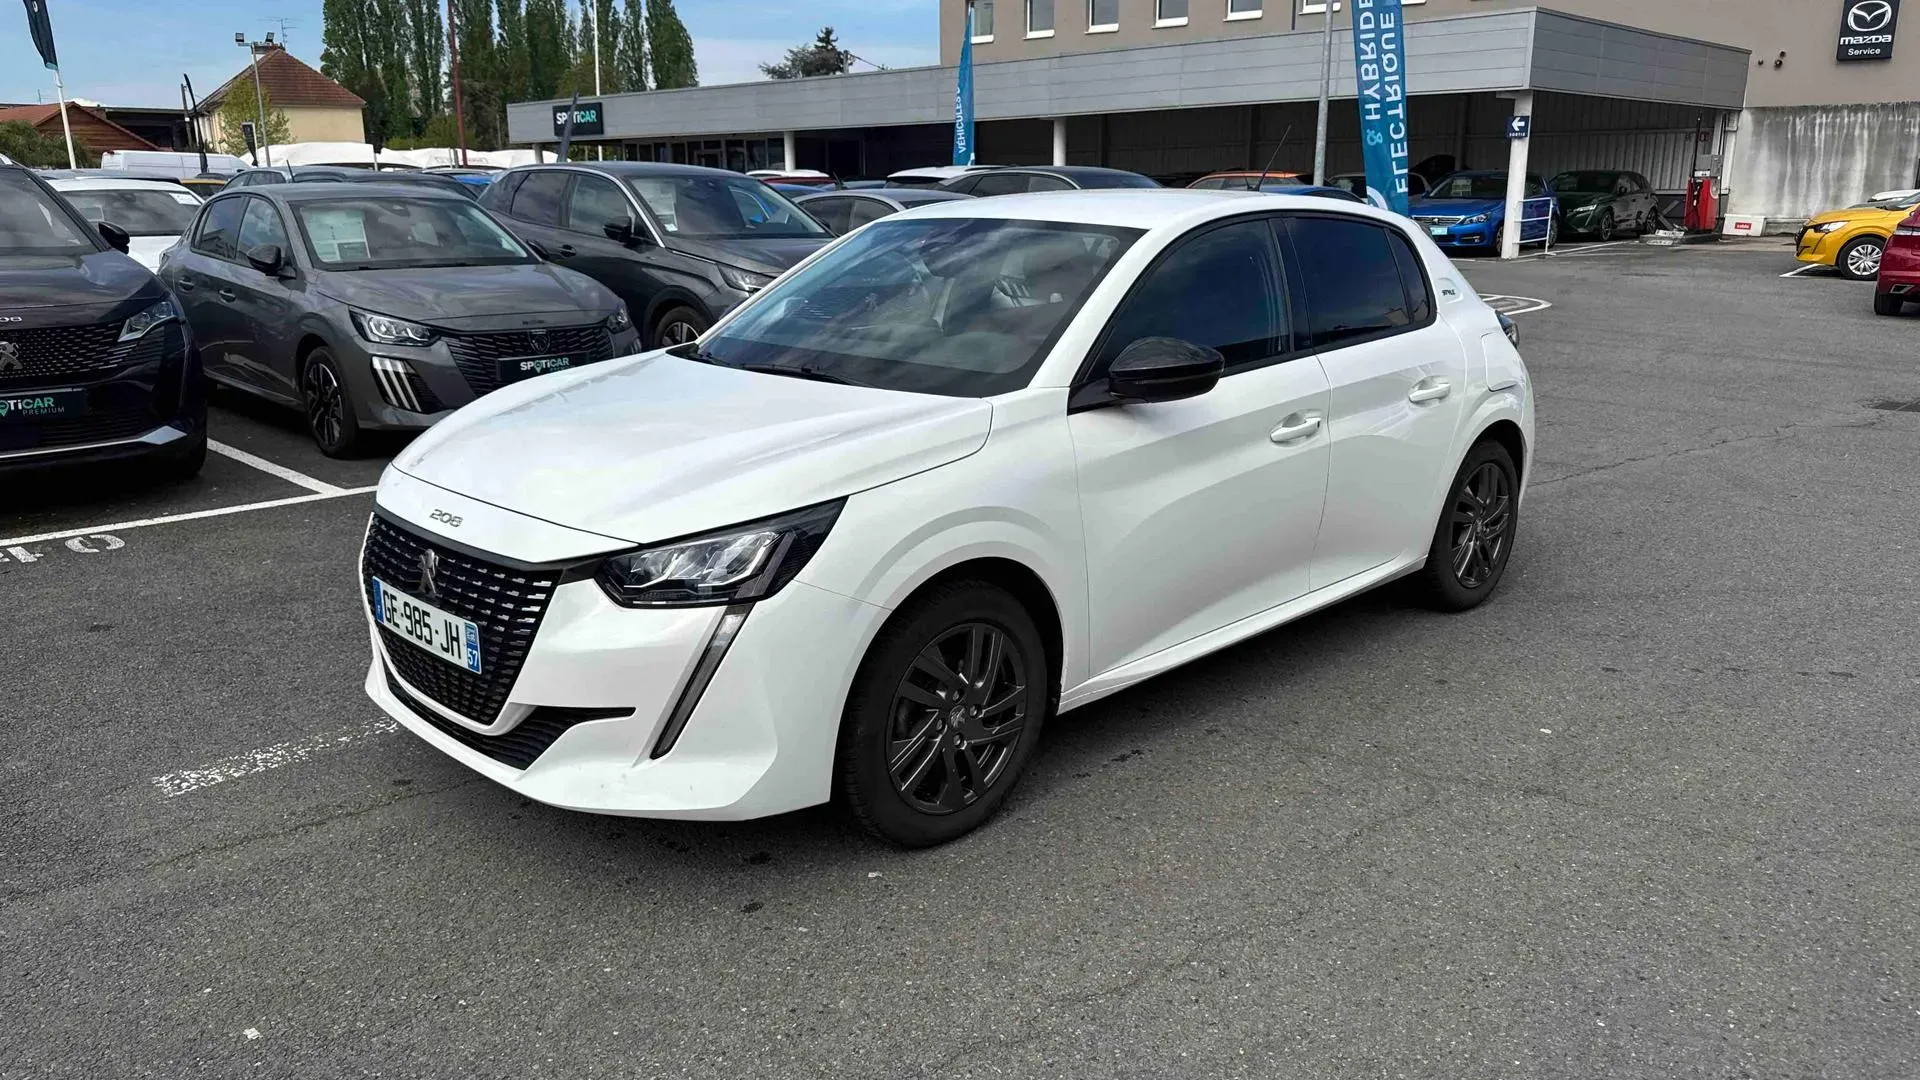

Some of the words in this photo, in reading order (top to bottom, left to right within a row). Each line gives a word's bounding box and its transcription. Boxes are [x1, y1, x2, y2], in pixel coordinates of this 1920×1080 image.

[1840, 35, 1892, 45] mazda
[1847, 47, 1881, 56] Service
[556, 110, 597, 124] SPTiCAR
[22, 406, 65, 416] PREMIUM
[429, 508, 463, 528] 208
[467, 647, 478, 666] 57
